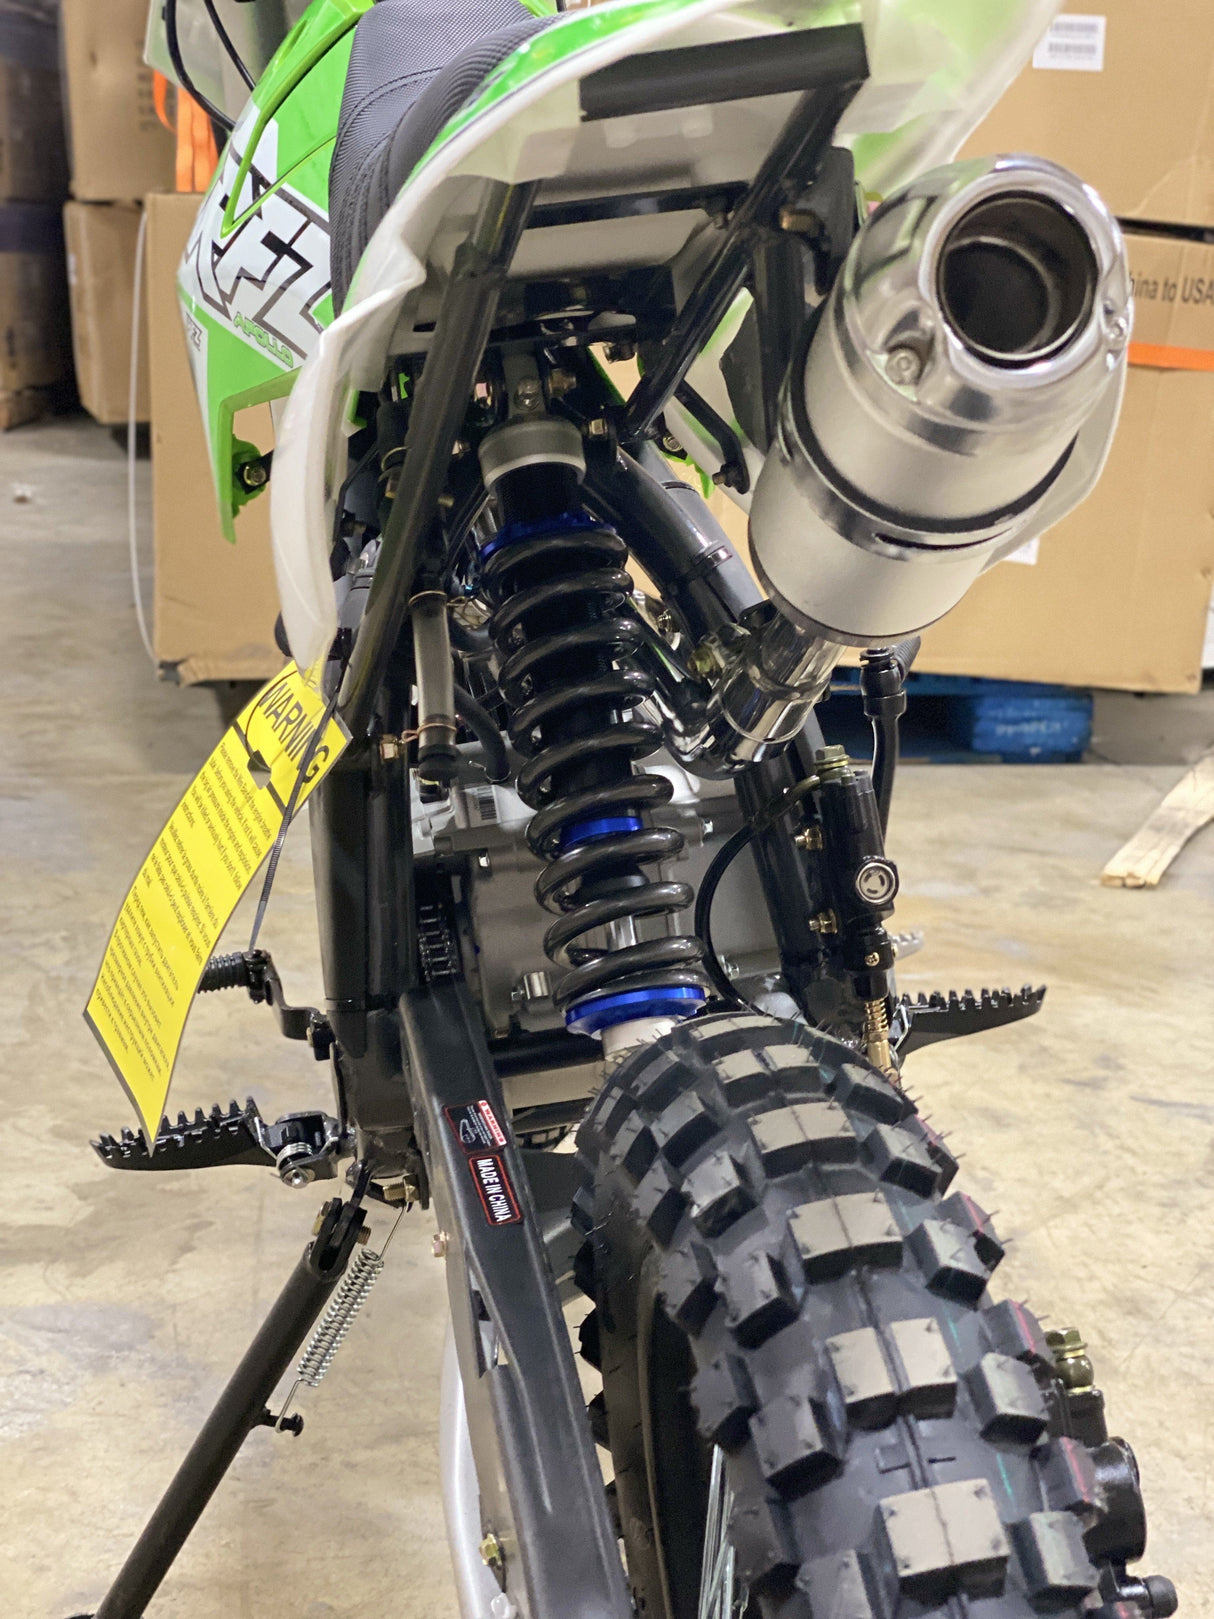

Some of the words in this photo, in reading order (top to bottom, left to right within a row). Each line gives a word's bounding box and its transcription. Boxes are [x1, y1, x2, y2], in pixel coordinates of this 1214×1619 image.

[1161, 276, 1178, 303] to
[1181, 276, 1214, 305] USA
[233, 311, 294, 369] APOLLO
[258, 681, 329, 783] WARNING
[476, 1158, 500, 1185] MADE
[485, 1184, 503, 1195] IN
[488, 1194, 512, 1222] CHINA
